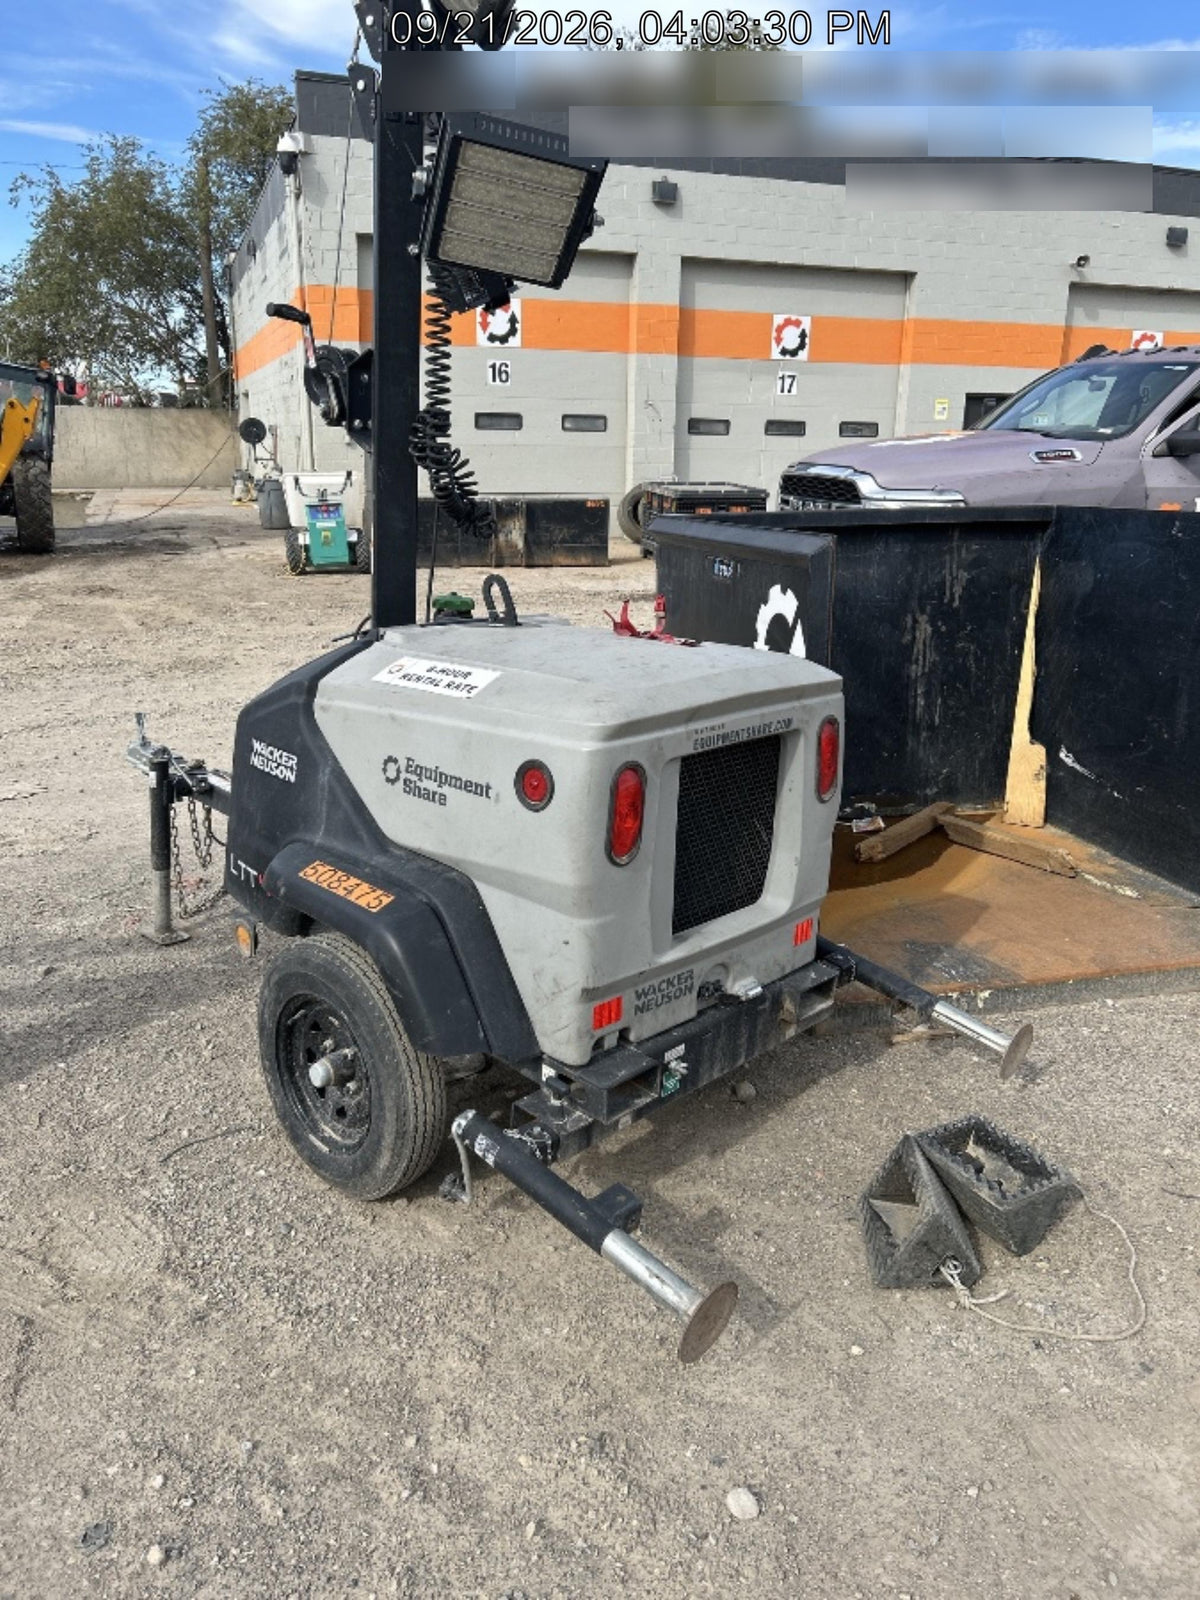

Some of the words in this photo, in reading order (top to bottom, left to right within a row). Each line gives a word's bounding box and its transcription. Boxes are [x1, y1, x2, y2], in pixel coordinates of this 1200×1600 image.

[488, 361, 510, 383] 16
[778, 374, 797, 394] 17
[399, 673, 444, 688] RENTAL
[443, 680, 479, 694] RATE
[250, 751, 296, 783] NEUSON
[251, 737, 298, 771] WACKER
[402, 777, 447, 806] Share
[405, 756, 492, 800] Equipment
[303, 863, 391, 909] 508475
[634, 968, 694, 1001] WACKER
[634, 980, 694, 1016] NEUSON
